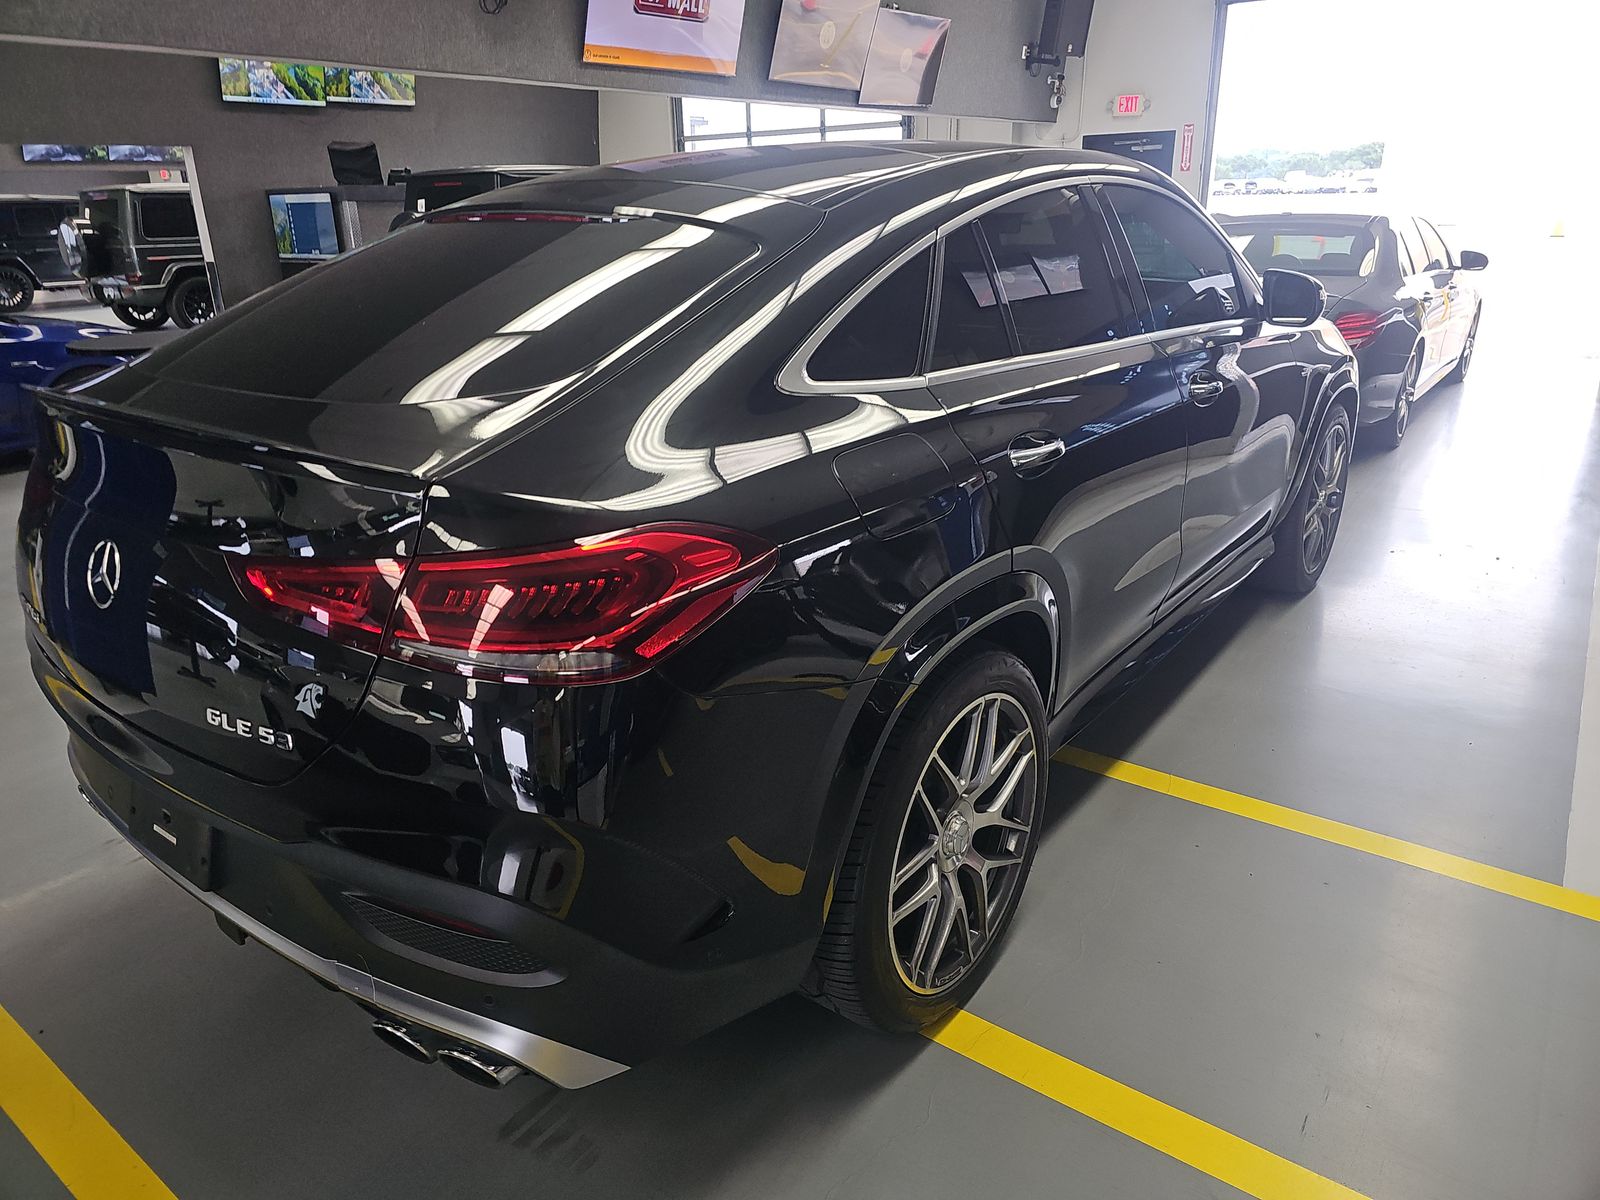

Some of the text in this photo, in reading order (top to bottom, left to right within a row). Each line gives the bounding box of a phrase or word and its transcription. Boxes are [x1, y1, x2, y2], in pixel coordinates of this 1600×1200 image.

[1119, 96, 1139, 112] EXIT
[206, 707, 293, 750] GLE 53
